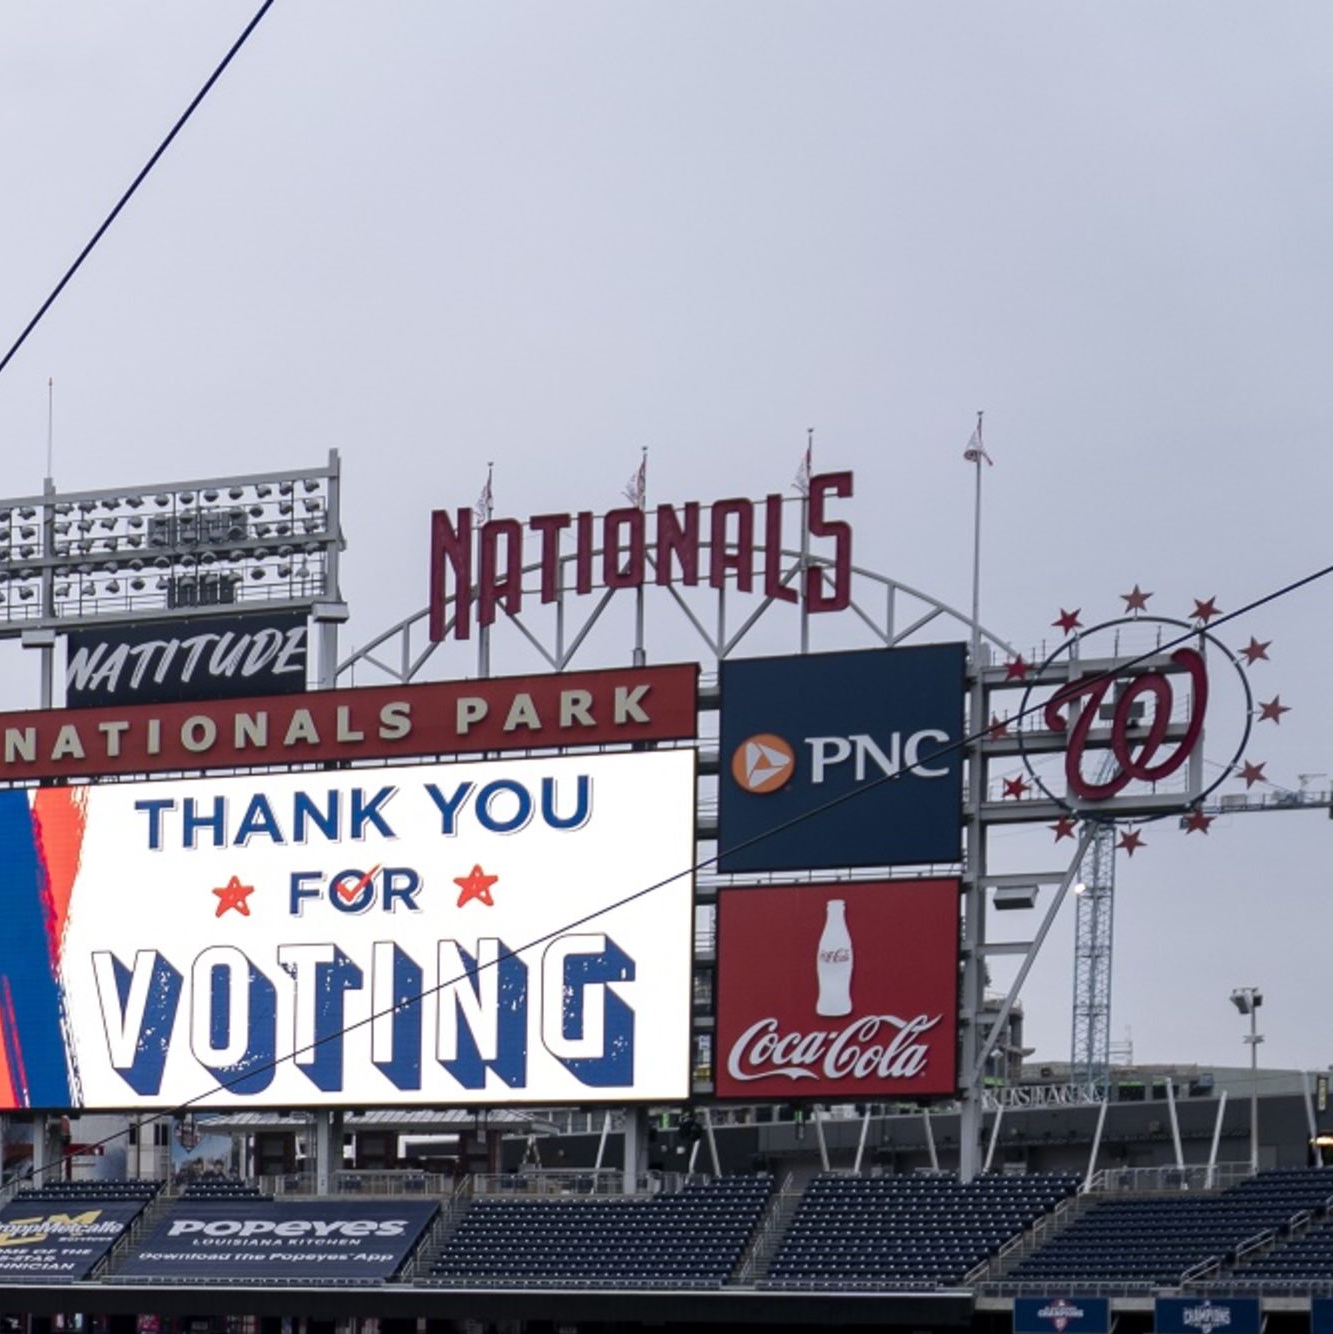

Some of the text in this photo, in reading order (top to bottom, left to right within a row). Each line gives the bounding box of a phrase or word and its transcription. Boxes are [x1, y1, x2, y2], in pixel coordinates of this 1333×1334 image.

[428, 470, 854, 643] NATIONALS
[68, 626, 309, 693] NATITUDE
[4, 685, 652, 764] NATIONALS PARK
[804, 729, 952, 785] PNC
[134, 775, 593, 853] THANK YOU
[288, 866, 423, 918] FOR
[90, 932, 637, 1097] VOTING
[727, 1012, 944, 1081] Coca-Cola
[192, 1238, 362, 1246] LOUISIANA KITCHEN
